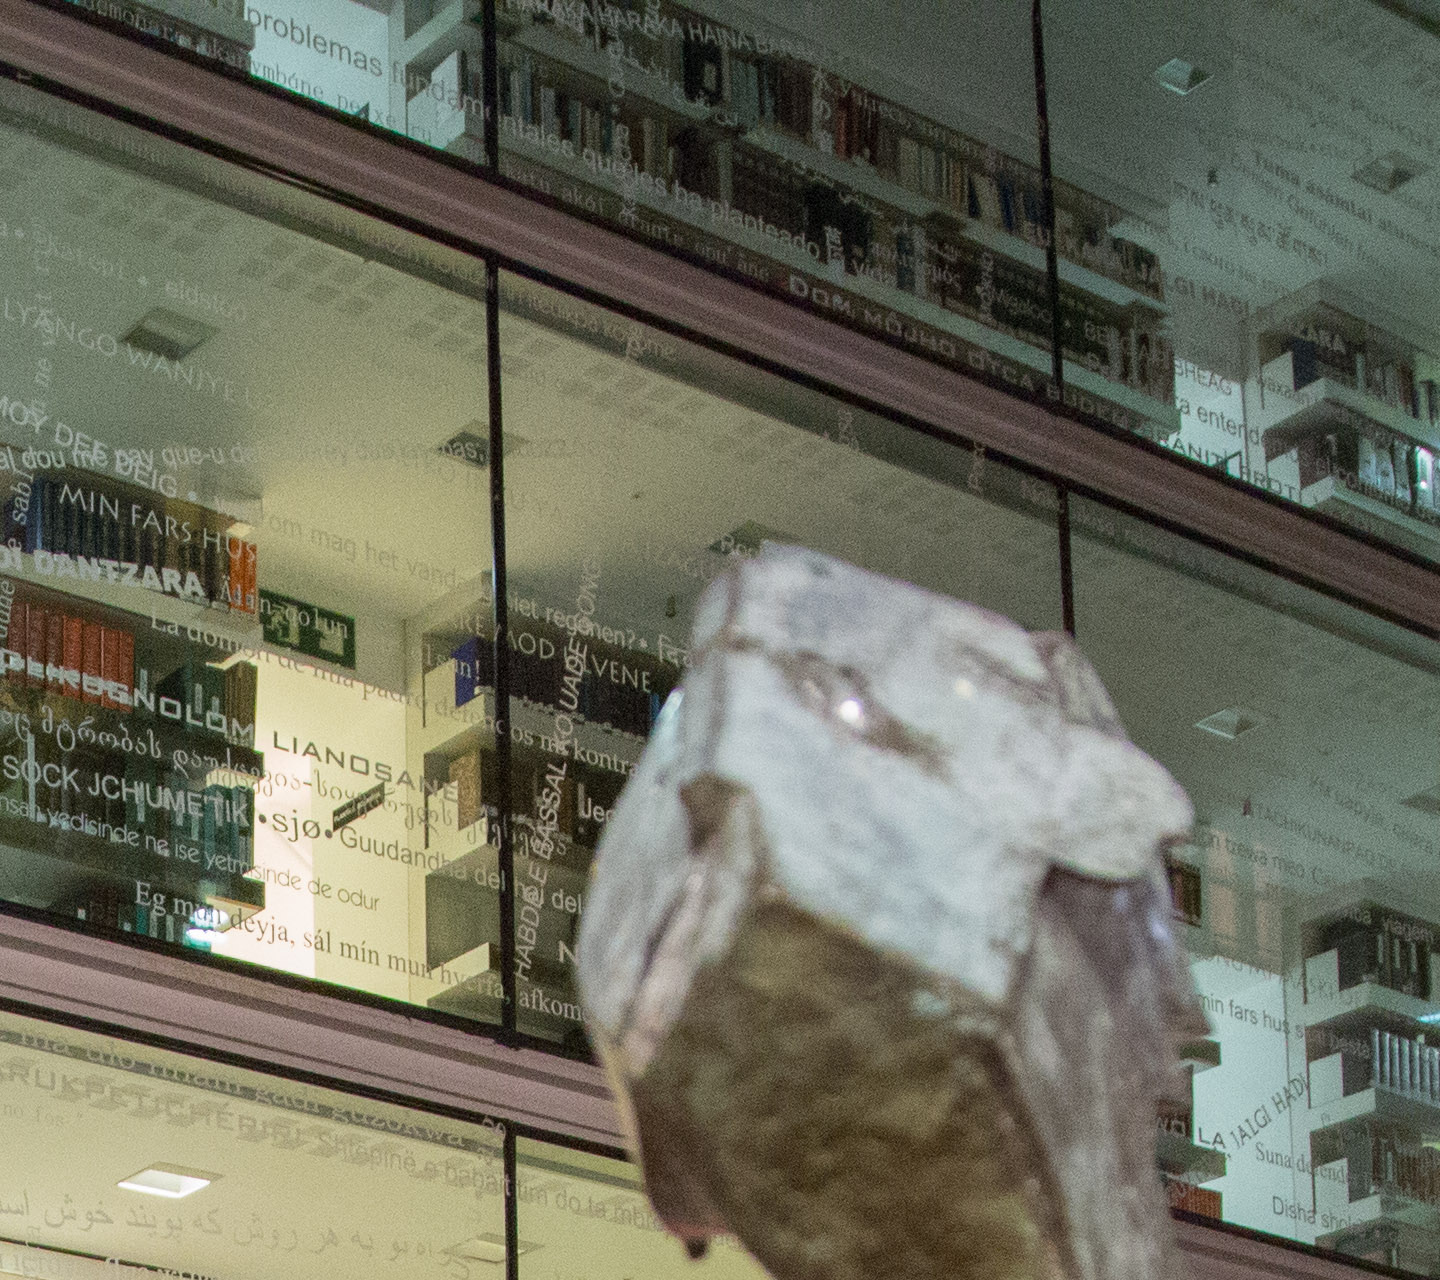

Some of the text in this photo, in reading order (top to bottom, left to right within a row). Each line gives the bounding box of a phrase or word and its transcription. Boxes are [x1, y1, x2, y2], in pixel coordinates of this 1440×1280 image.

[244, 5, 384, 78] problemas
[310, 526, 357, 562] mag
[365, 539, 399, 569] het
[271, 729, 459, 803] LIANOSANE
[270, 808, 320, 845] sjø
[307, 877, 333, 901] de
[336, 881, 381, 913] odur
[135, 881, 167, 918] Eg
[303, 927, 333, 956] sál
[1229, 1003, 1258, 1024] fars
